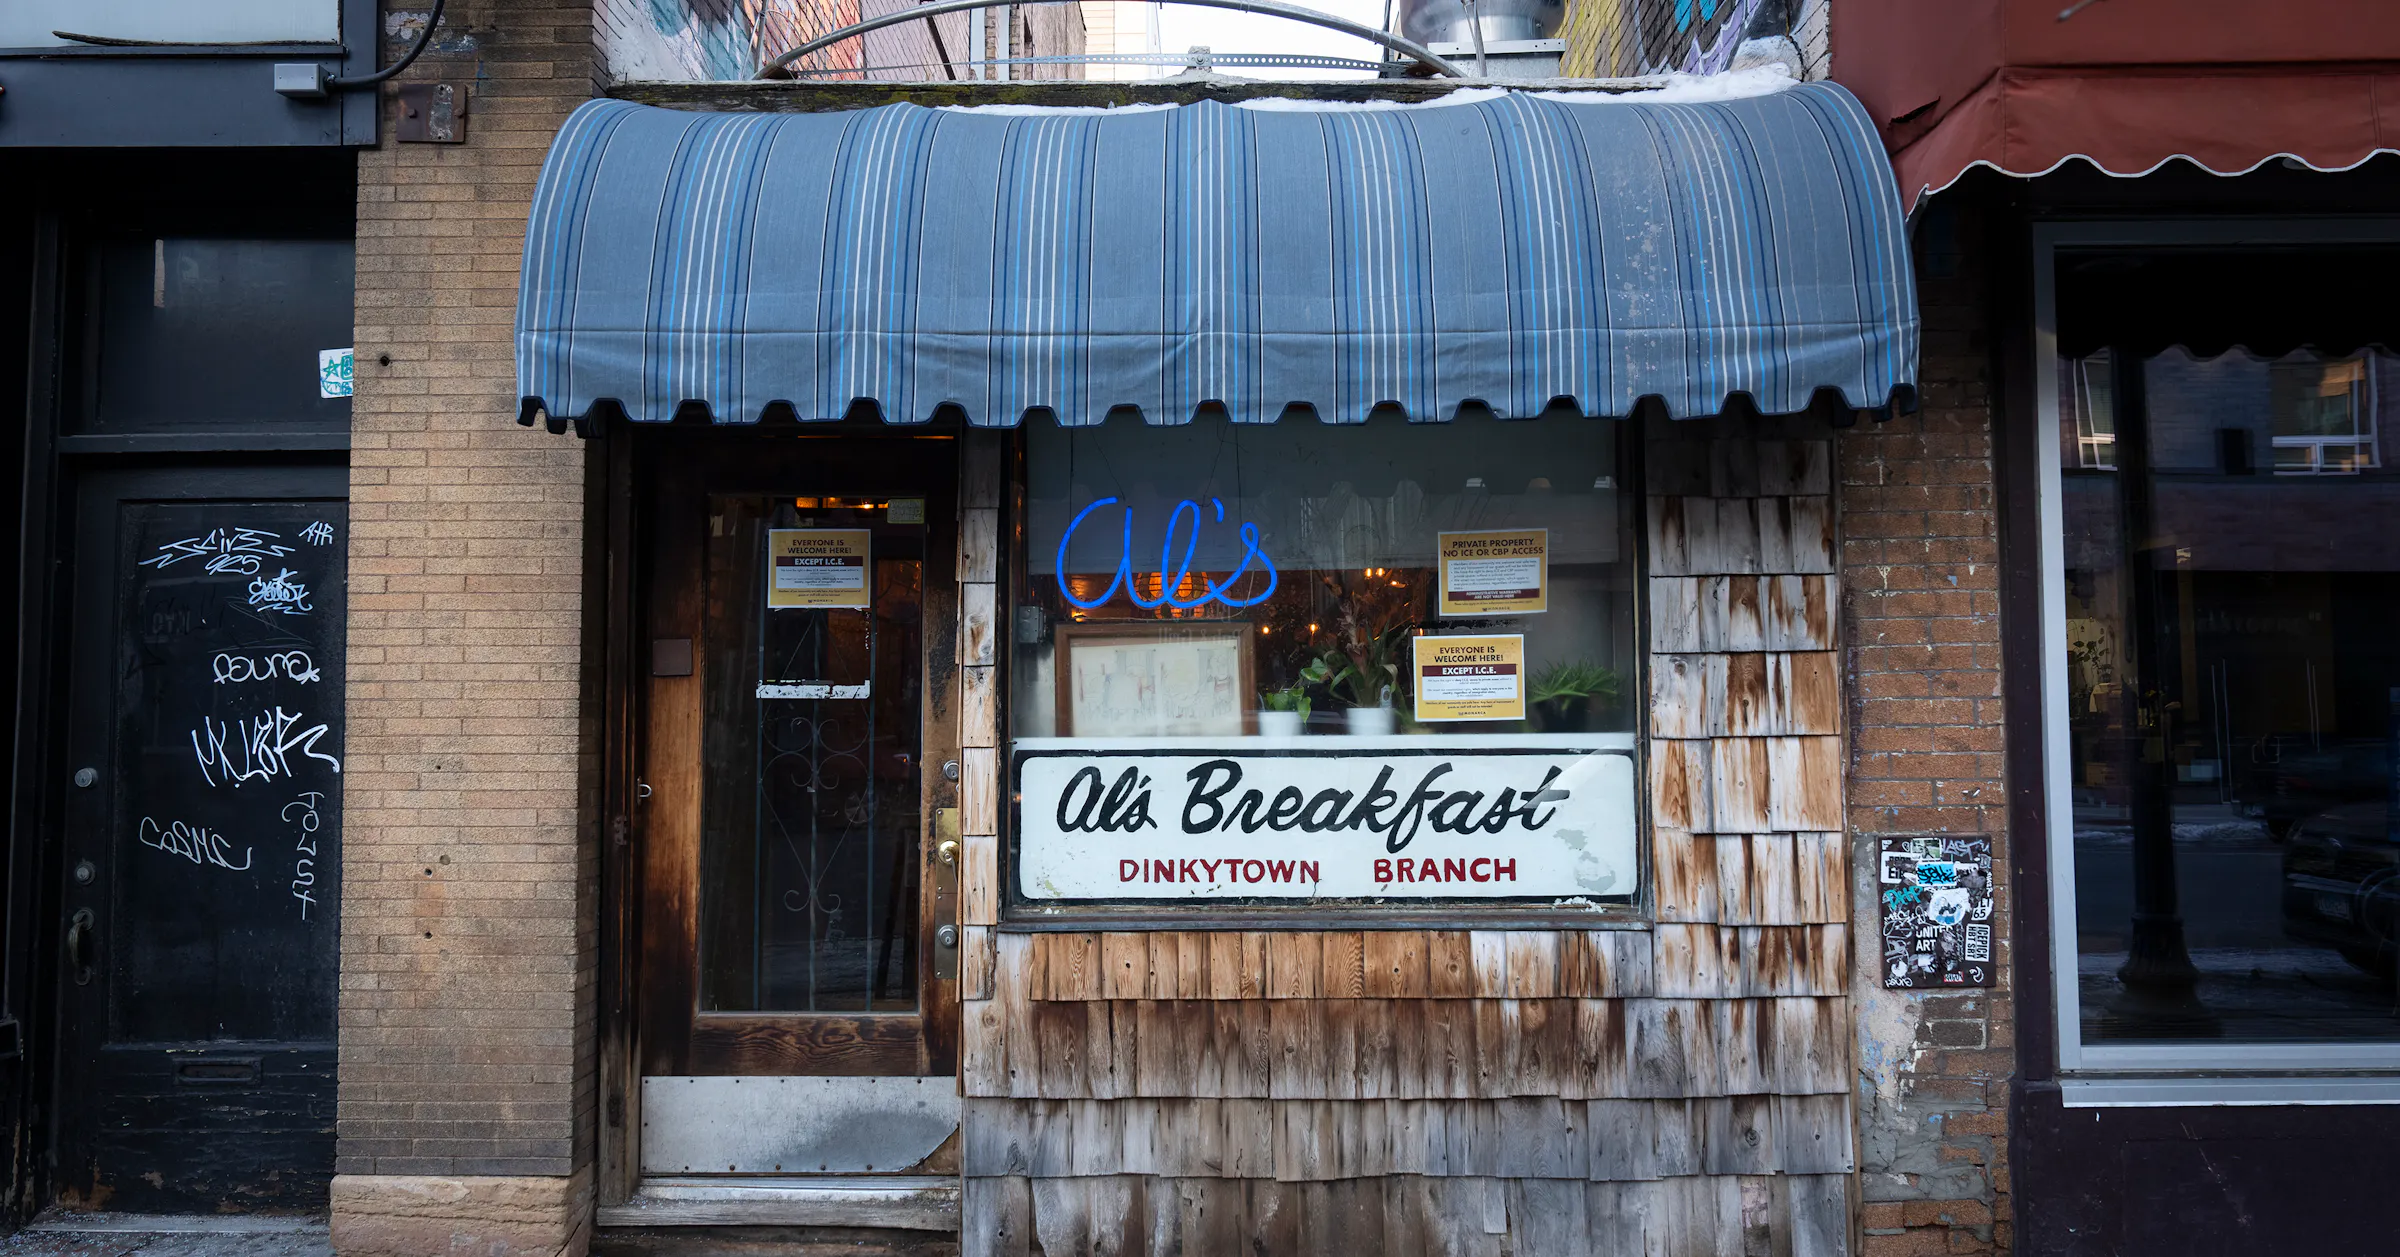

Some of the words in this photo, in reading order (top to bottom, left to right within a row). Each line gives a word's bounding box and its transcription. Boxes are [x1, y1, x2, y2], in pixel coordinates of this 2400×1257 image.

[1452, 540, 1487, 549] PRIVATE
[1490, 538, 1534, 547] PROPERTY
[1056, 497, 1278, 609] Al's
[1443, 550, 1458, 558] NO
[1461, 549, 1473, 557] ICE
[1476, 548, 1490, 556] OR
[1511, 546, 1544, 554] ACCESS
[794, 558, 824, 566] EXCEPT
[825, 558, 845, 566] I.C.E.
[1439, 646, 1484, 654] EVERYONE
[1487, 645, 1495, 653] IS
[1434, 655, 1476, 663] WELCOME
[1479, 654, 1504, 662] HERE!
[1442, 666, 1473, 675] EXCEPT
[1475, 666, 1497, 674] I.C.E.
[1057, 766, 1158, 833] Al's
[1182, 759, 1570, 854] Breakfast
[1119, 858, 1319, 884] DINKYTOWN
[1374, 858, 1516, 883] BRANCH
[1973, 908, 1986, 919] 65
[1915, 939, 1936, 952] ART
[1976, 926, 1989, 960] ICEPICK
